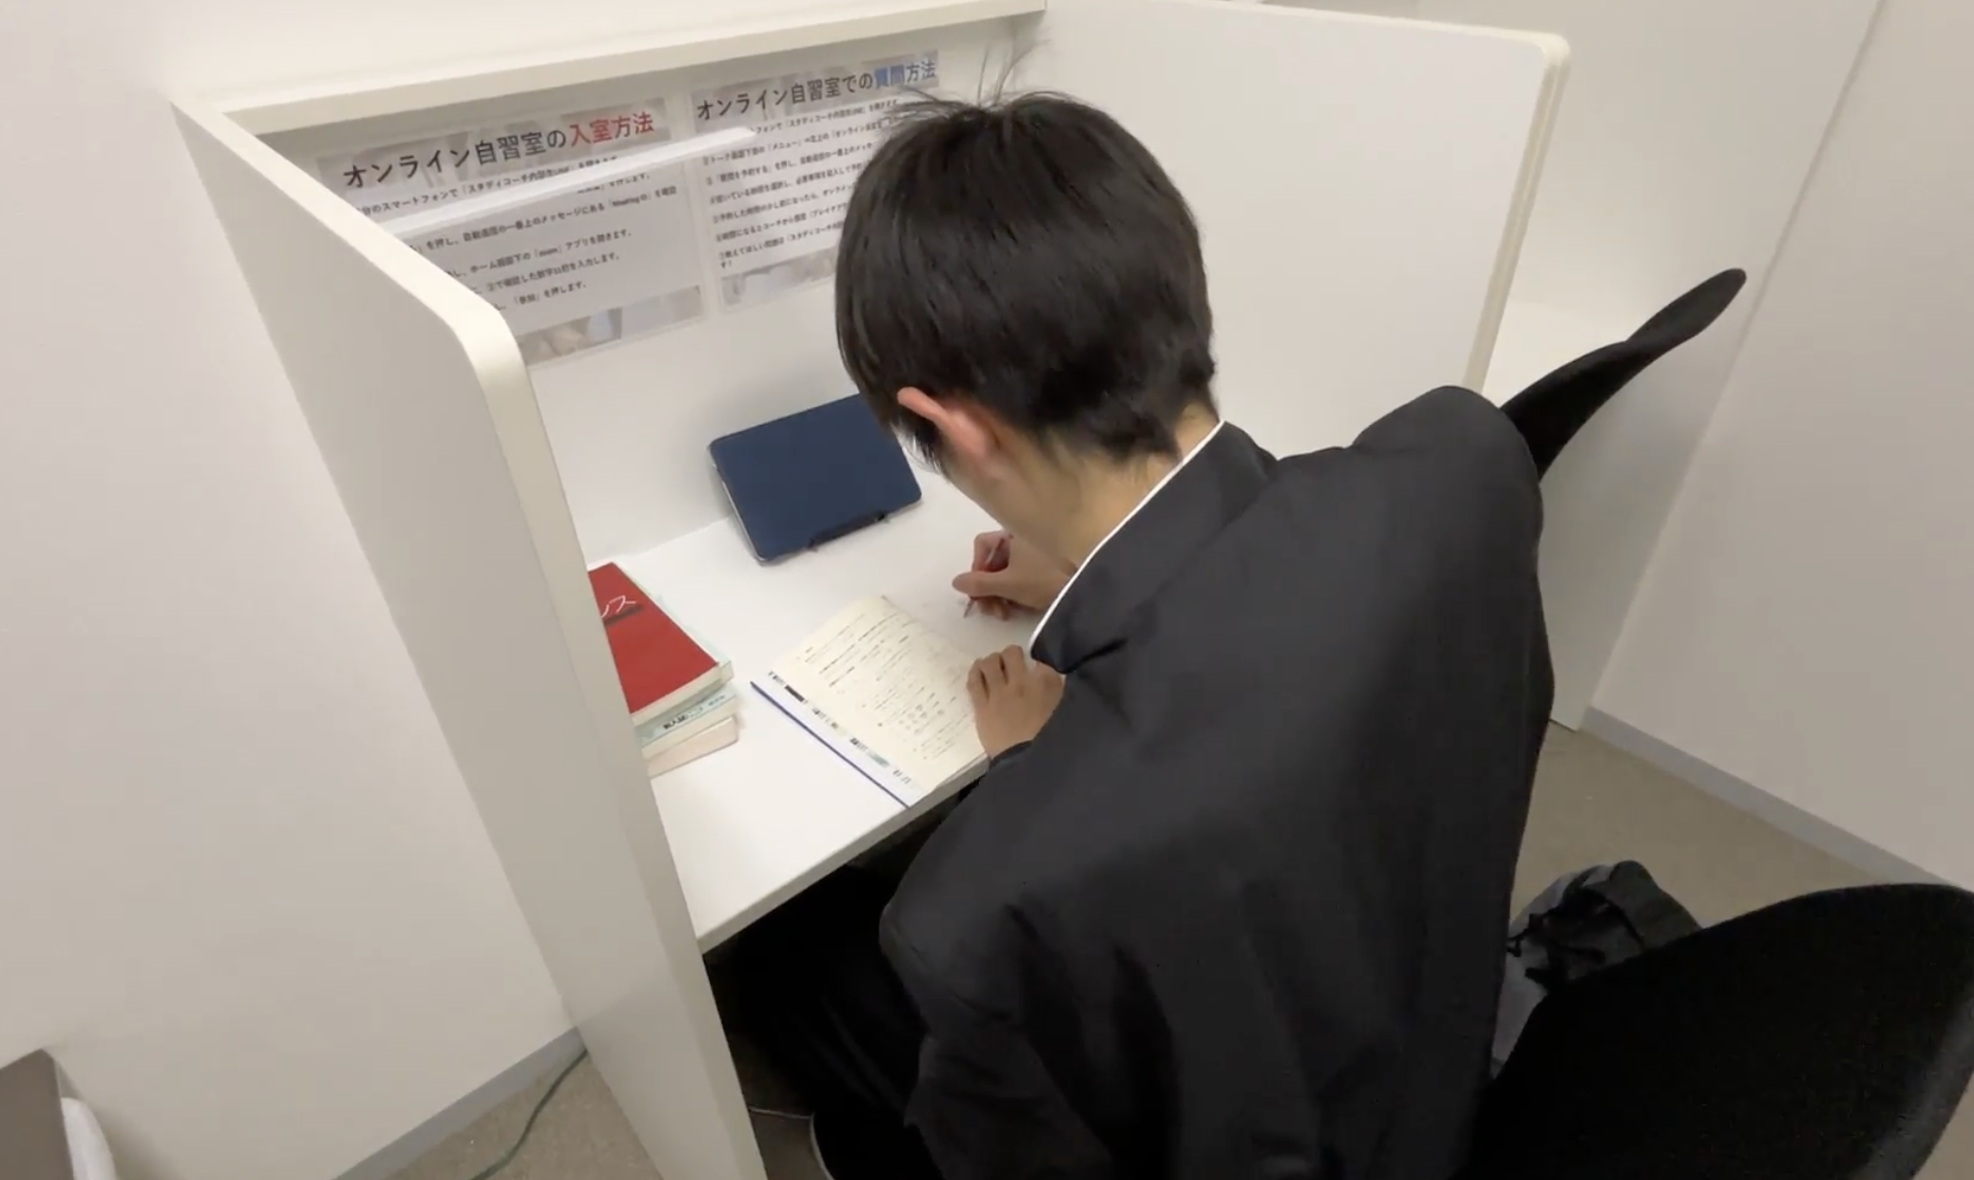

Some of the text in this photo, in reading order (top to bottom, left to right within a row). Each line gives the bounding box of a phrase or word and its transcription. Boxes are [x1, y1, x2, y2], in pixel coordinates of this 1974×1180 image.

[697, 60, 936, 120] オンライン自習室での質問方法
[343, 111, 655, 189] オンライン自習室の入室方法
